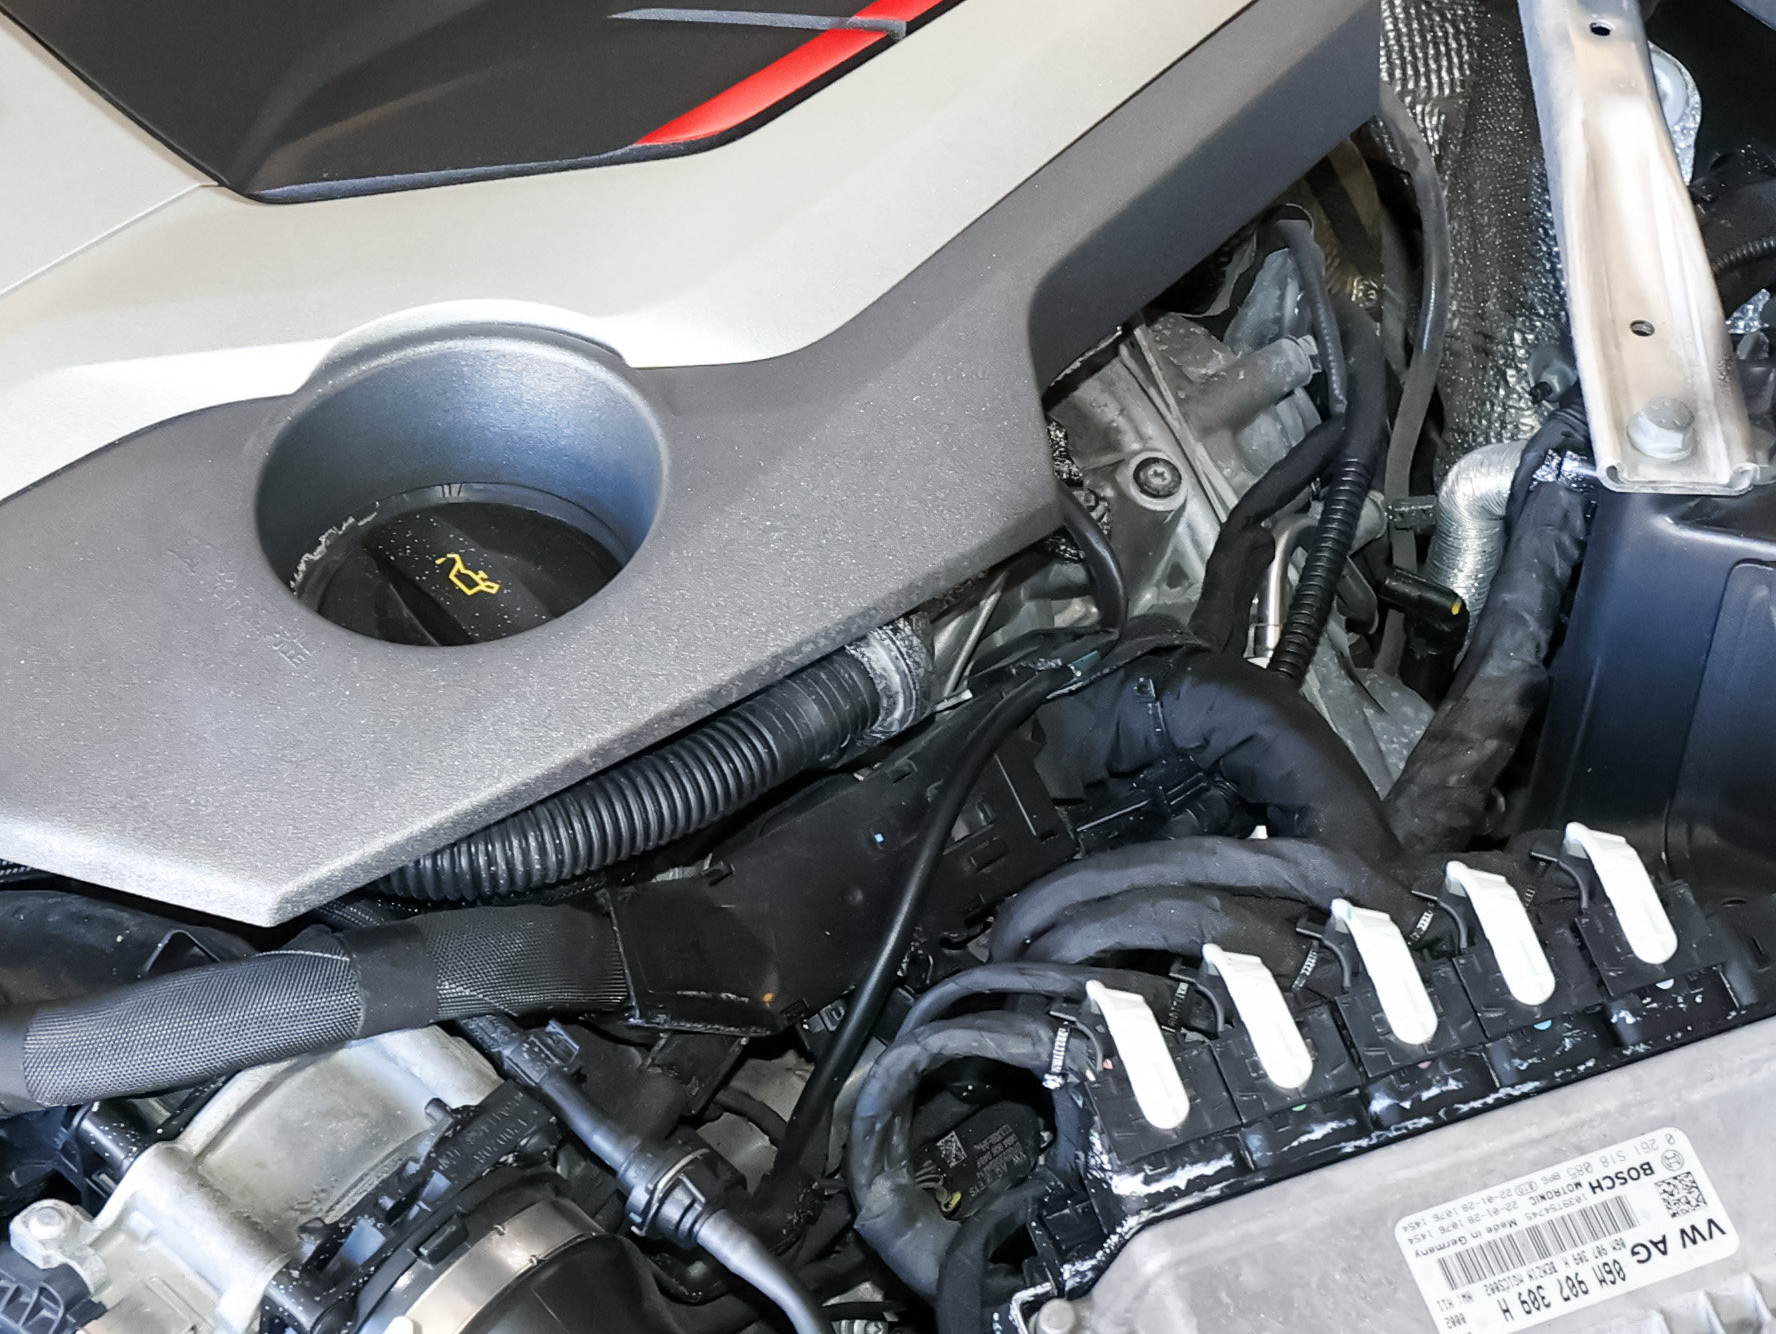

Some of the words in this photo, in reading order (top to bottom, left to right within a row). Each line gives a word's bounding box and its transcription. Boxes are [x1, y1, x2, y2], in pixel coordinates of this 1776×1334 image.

[1632, 1137, 1659, 1156] 261
[1565, 1160, 1594, 1180] 085
[1587, 1160, 1655, 1195] BOSCH
[1527, 1179, 1583, 1205] MOTRONIC
[1470, 1229, 1483, 1241] in
[1484, 1217, 1517, 1236] Made
[1674, 1215, 1726, 1249] VW
[1412, 1232, 1468, 1260] Germany
[1626, 1233, 1674, 1266] AG
[1553, 1270, 1590, 1302] 907
[1590, 1257, 1628, 1289] 06M
[1495, 1297, 1514, 1322] H
[1514, 1283, 1553, 1316] 309
